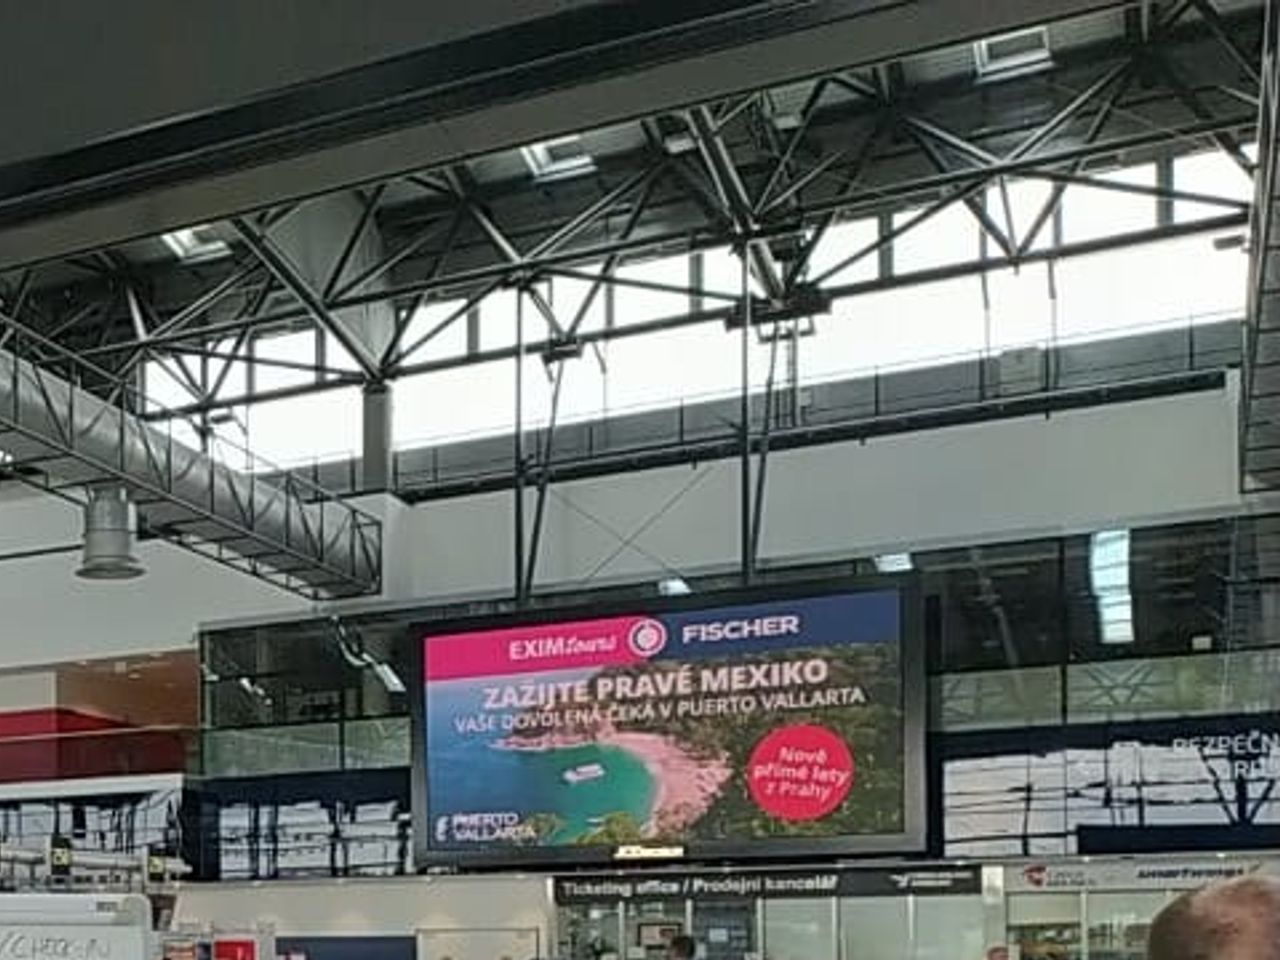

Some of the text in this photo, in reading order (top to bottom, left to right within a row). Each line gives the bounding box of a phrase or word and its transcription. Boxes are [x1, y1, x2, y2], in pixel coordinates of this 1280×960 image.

[682, 615, 800, 644] FISCHER
[483, 658, 829, 711] ZAŽIJTE PRAVÉ MEXIKO
[658, 700, 672, 718] V
[677, 696, 756, 718] PUERTO
[762, 686, 866, 711] VALLARTA
[561, 881, 632, 897] Ticketing
[636, 879, 680, 894] office
